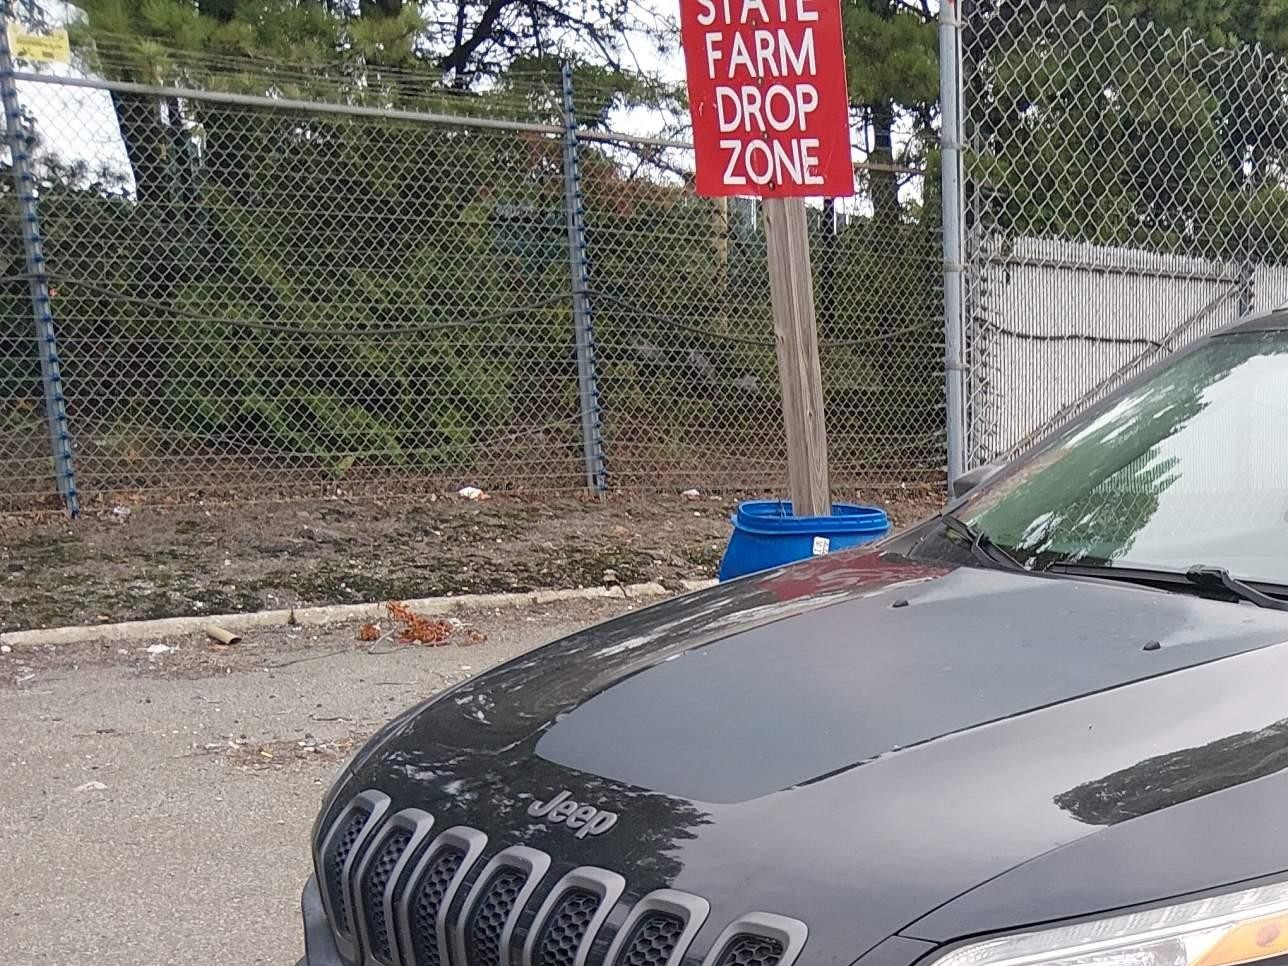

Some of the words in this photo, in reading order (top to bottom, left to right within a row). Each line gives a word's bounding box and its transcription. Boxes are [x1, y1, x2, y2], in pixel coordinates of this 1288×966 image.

[706, 27, 817, 79] FARM
[715, 84, 819, 132] DROP
[720, 138, 824, 185] ZONE
[527, 790, 618, 839] Jeep
